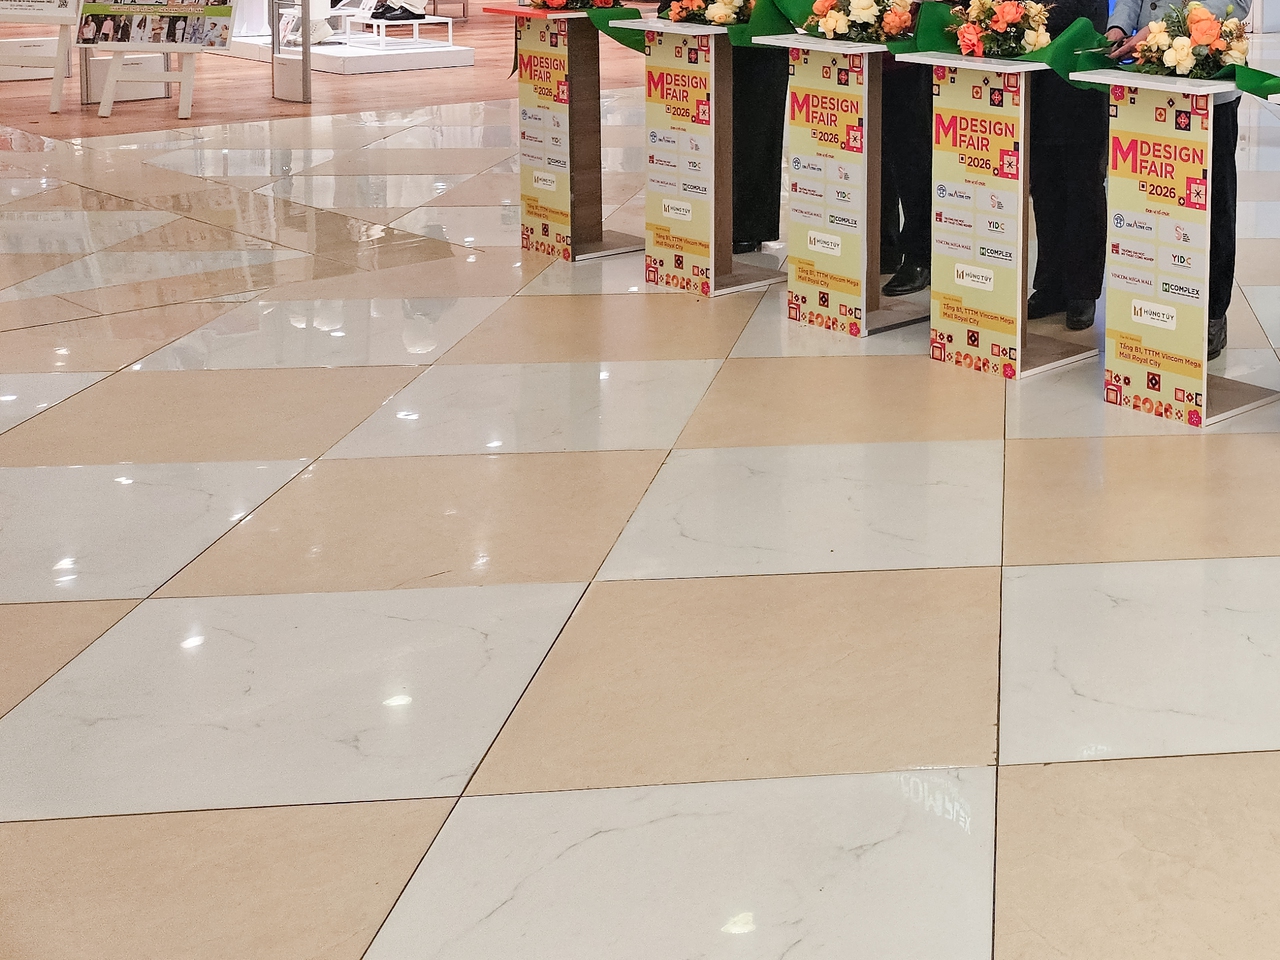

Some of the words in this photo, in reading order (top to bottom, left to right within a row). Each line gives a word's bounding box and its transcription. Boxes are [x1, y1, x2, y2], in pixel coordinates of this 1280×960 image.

[518, 53, 533, 81] M
[533, 56, 566, 72] DESIGN
[533, 69, 552, 84] FAIR
[647, 70, 664, 100] M
[665, 72, 707, 90] DESIGN
[538, 85, 553, 97] 2026
[665, 87, 689, 103] FAIR
[672, 106, 690, 118] 2026
[790, 91, 811, 123] M
[811, 94, 859, 115] DESIGN
[811, 110, 838, 127] FAIR
[818, 131, 839, 144] 2026
[935, 113, 958, 147] M
[959, 116, 1015, 138] DESIGN
[958, 133, 990, 152] FAIR
[967, 156, 991, 170] 2026
[1111, 136, 1138, 174] M
[1139, 140, 1204, 165] DESIGN
[1139, 158, 1175, 180] FAIR
[1148, 183, 1176, 199] 2026
